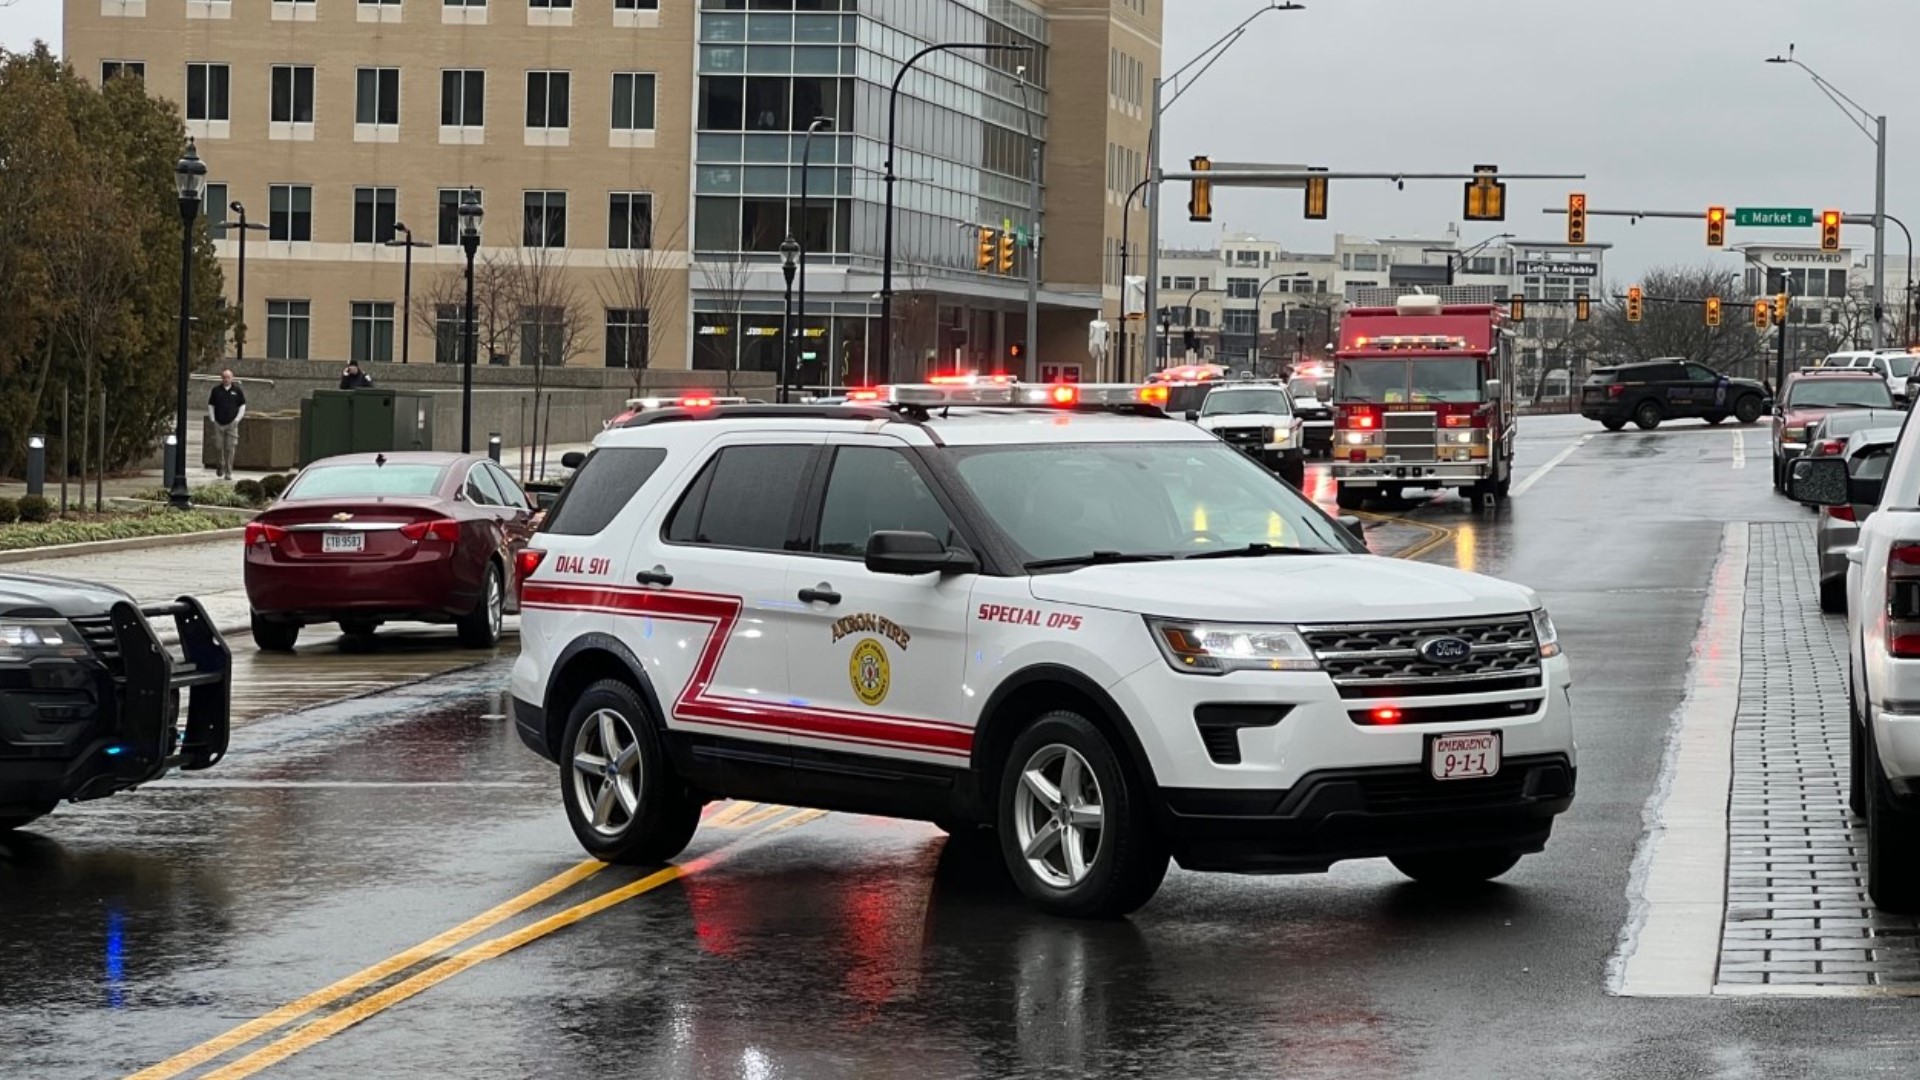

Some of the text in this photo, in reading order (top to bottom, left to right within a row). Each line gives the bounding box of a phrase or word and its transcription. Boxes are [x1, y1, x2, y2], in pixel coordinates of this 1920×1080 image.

[1741, 214, 1747, 223] E
[1752, 212, 1792, 223] Market
[1772, 252, 1842, 263] COURTYARD
[1527, 264, 1594, 274] Lofts Available
[555, 555, 611, 576] DIAL 911
[978, 603, 1083, 631] SPECIAL OPS
[831, 613, 911, 651] AKRON FIRE
[1436, 642, 1464, 656] Ford
[1438, 737, 1494, 753] EMERGENCY
[1445, 753, 1488, 773] 9-1-1
